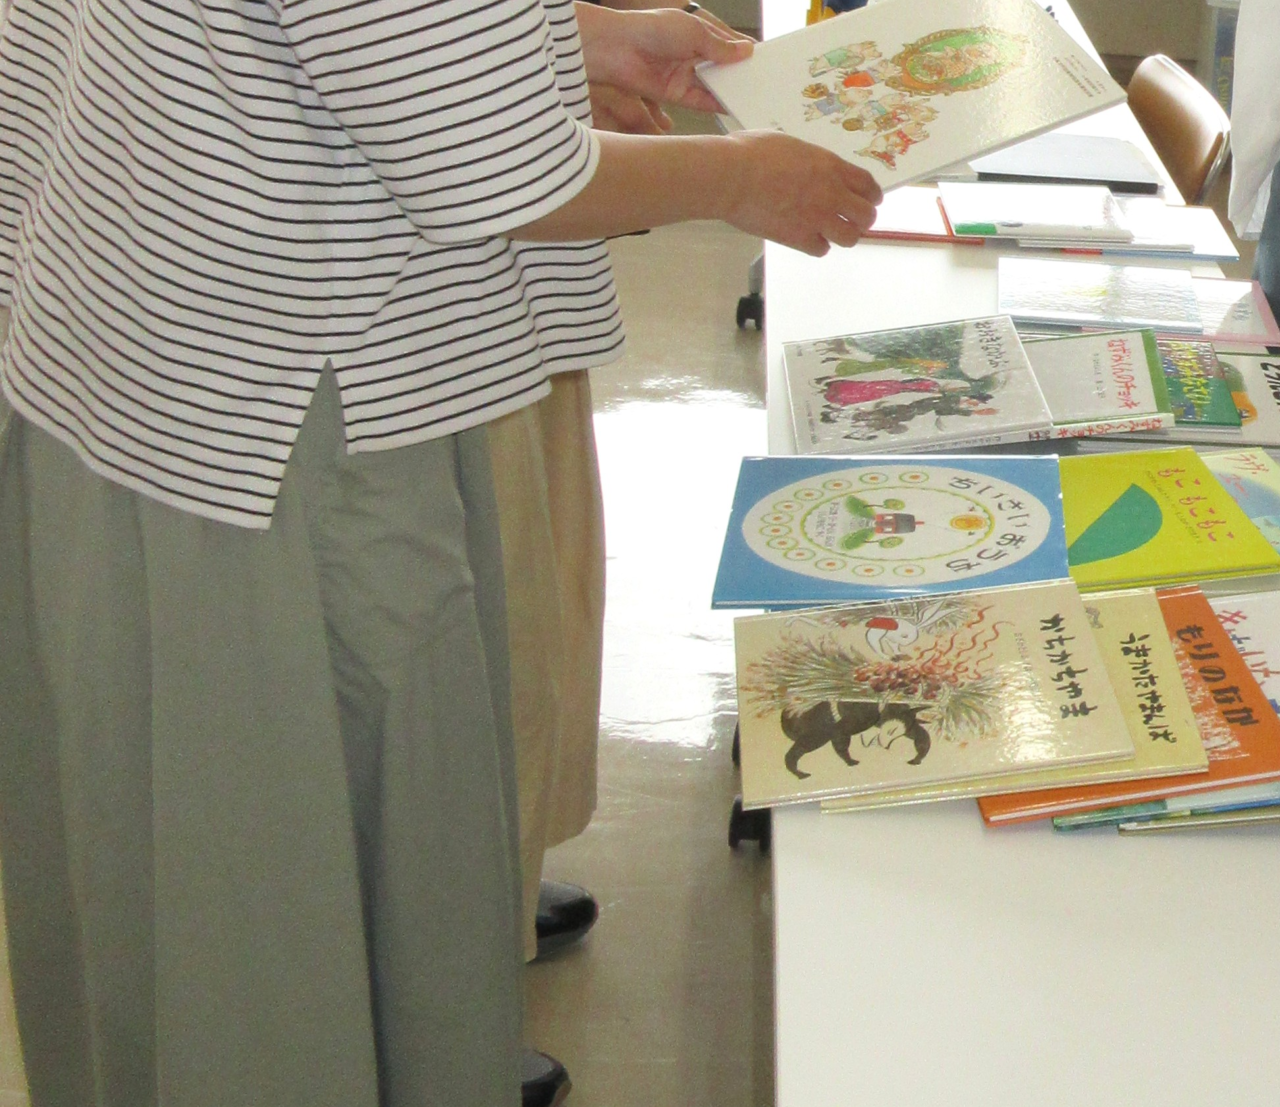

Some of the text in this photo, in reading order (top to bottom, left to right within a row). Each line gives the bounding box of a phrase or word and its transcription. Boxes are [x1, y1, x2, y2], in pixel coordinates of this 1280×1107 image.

[1157, 467, 1235, 542] もこもこもこ
[1039, 612, 1098, 719] かちかちやま
[1119, 632, 1177, 744] うまかたやまんば
[1176, 624, 1260, 727] もりのなか
